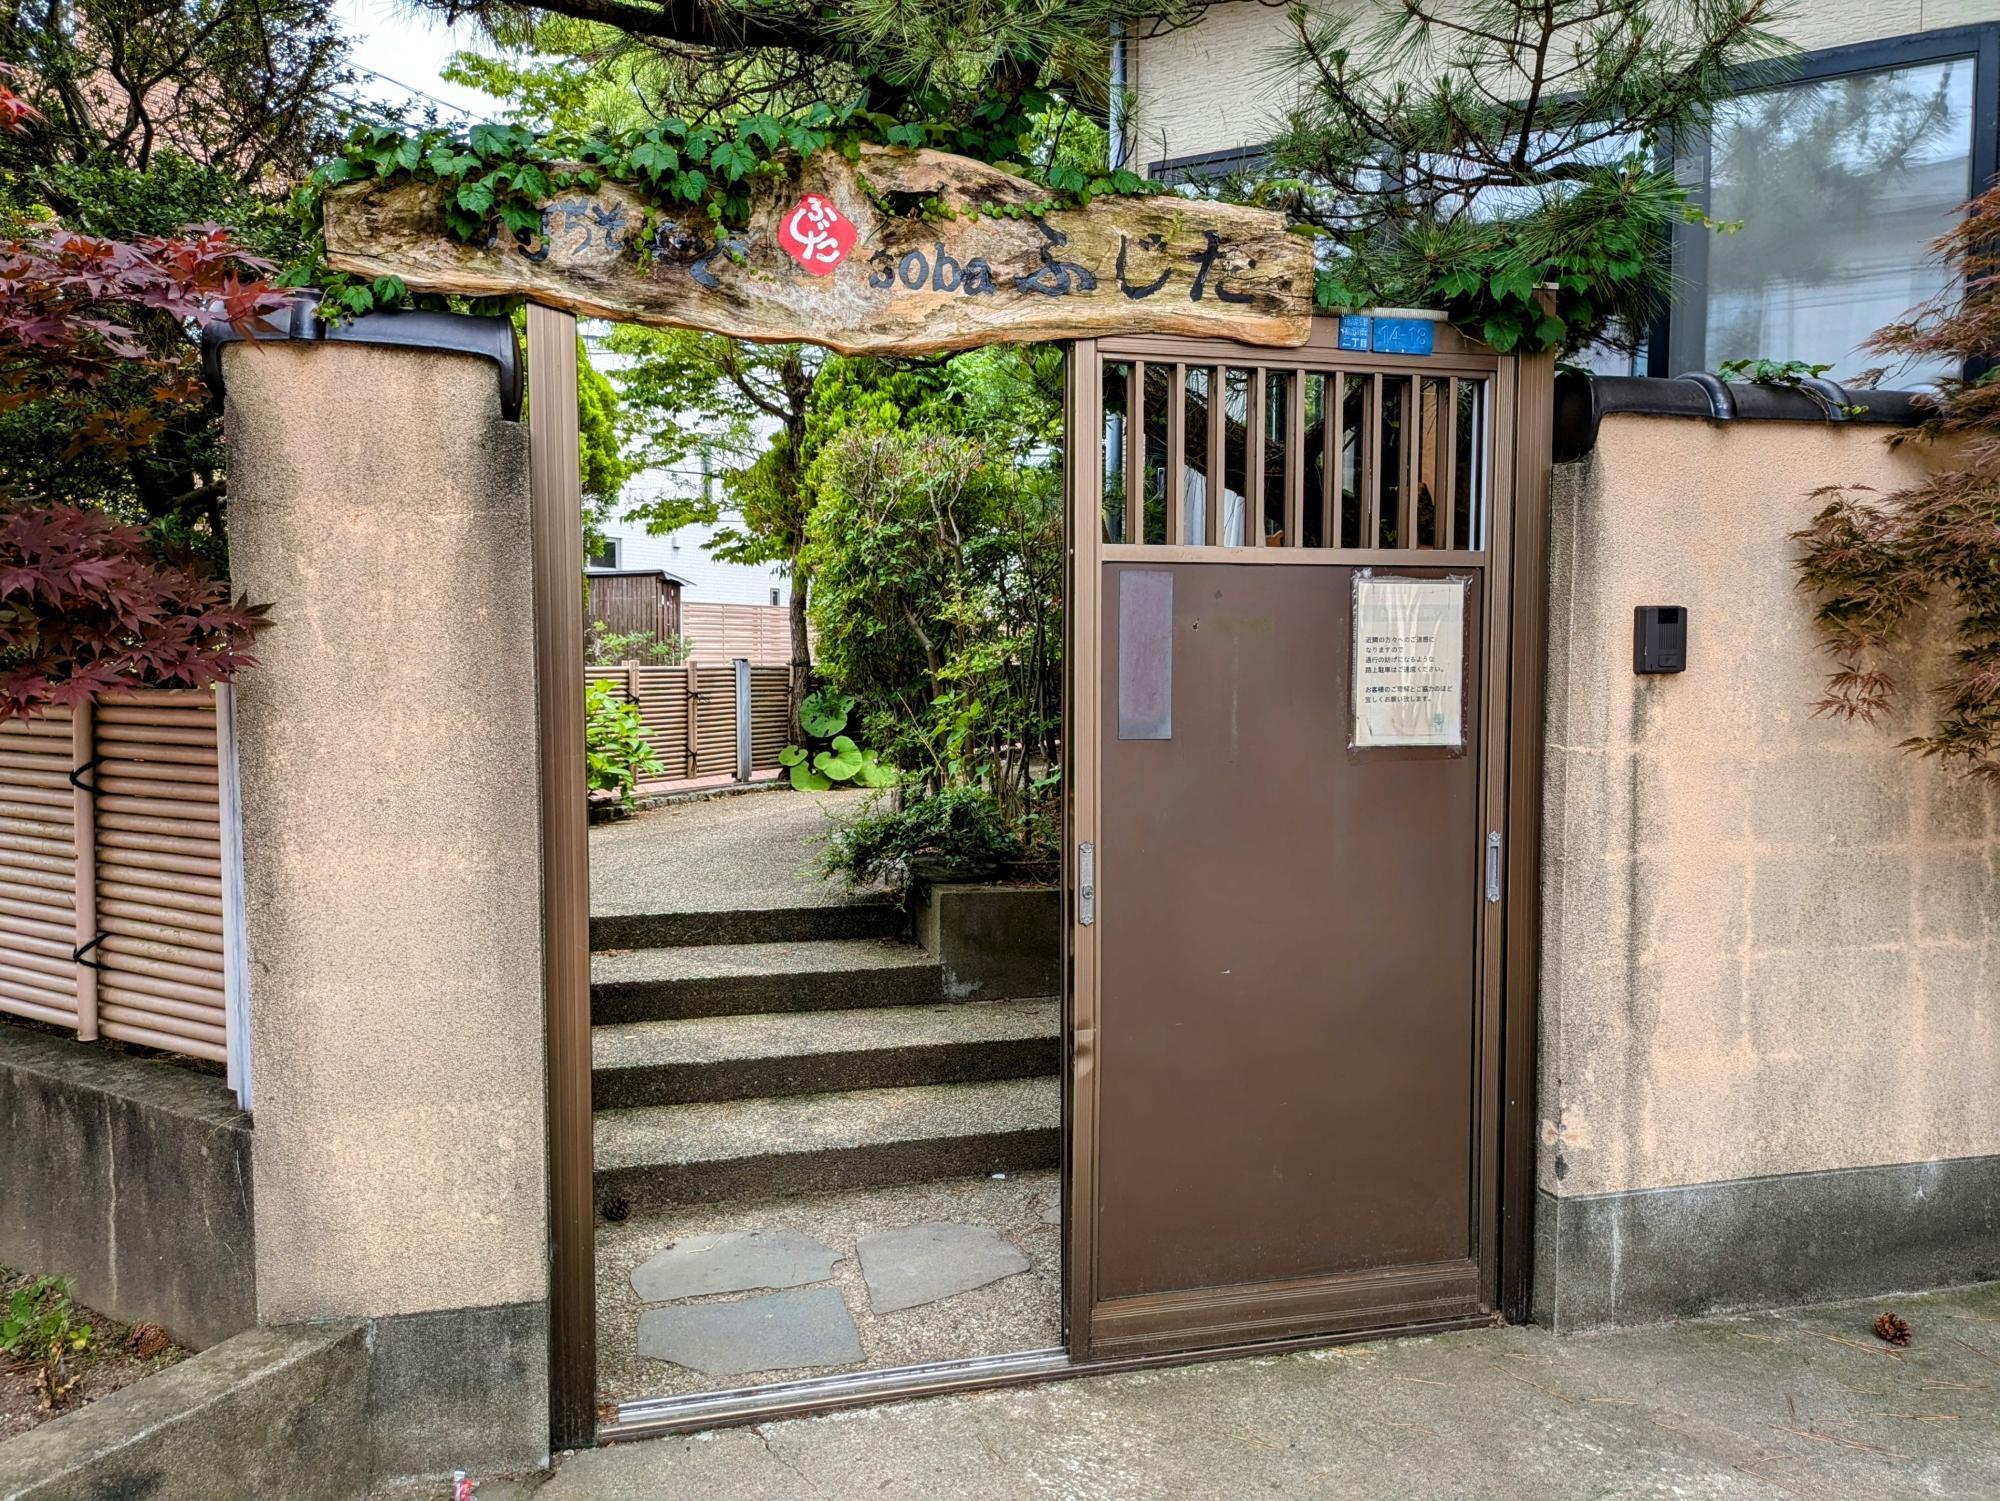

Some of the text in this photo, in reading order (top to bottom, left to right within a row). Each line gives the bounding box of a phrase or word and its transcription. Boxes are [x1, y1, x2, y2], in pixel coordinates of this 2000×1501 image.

[789, 196, 841, 263] ふじた
[868, 218, 1257, 304] soba ふじた
